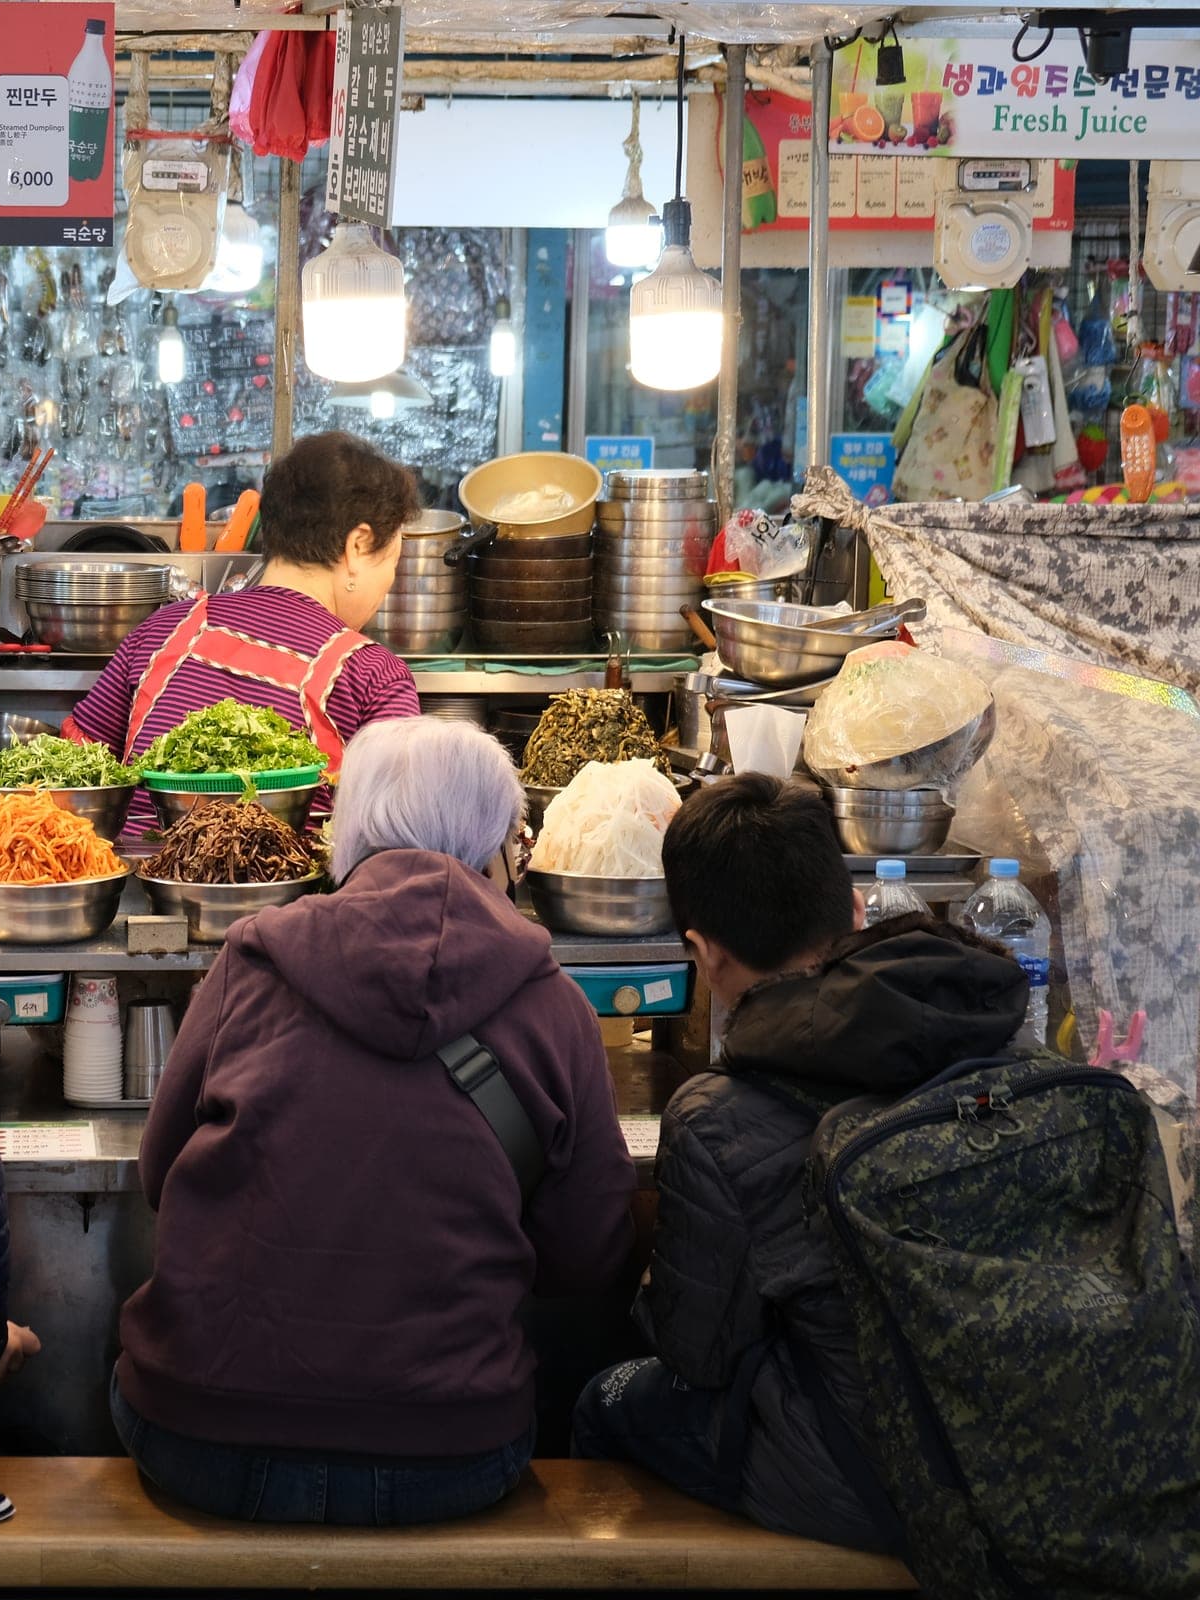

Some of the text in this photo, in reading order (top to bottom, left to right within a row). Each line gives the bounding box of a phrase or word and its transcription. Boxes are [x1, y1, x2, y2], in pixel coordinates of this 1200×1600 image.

[361, 22, 391, 55] 엄마손맛
[6, 87, 57, 107] 찐만두
[333, 88, 346, 138] 16
[29, 124, 65, 133] Dumplings
[347, 114, 391, 164] 칼수제비
[992, 104, 1148, 141] Fresh Juice
[10, 171, 53, 190] 6,000
[343, 165, 387, 217] 보리비빔밥
[63, 225, 107, 242] 국순당
